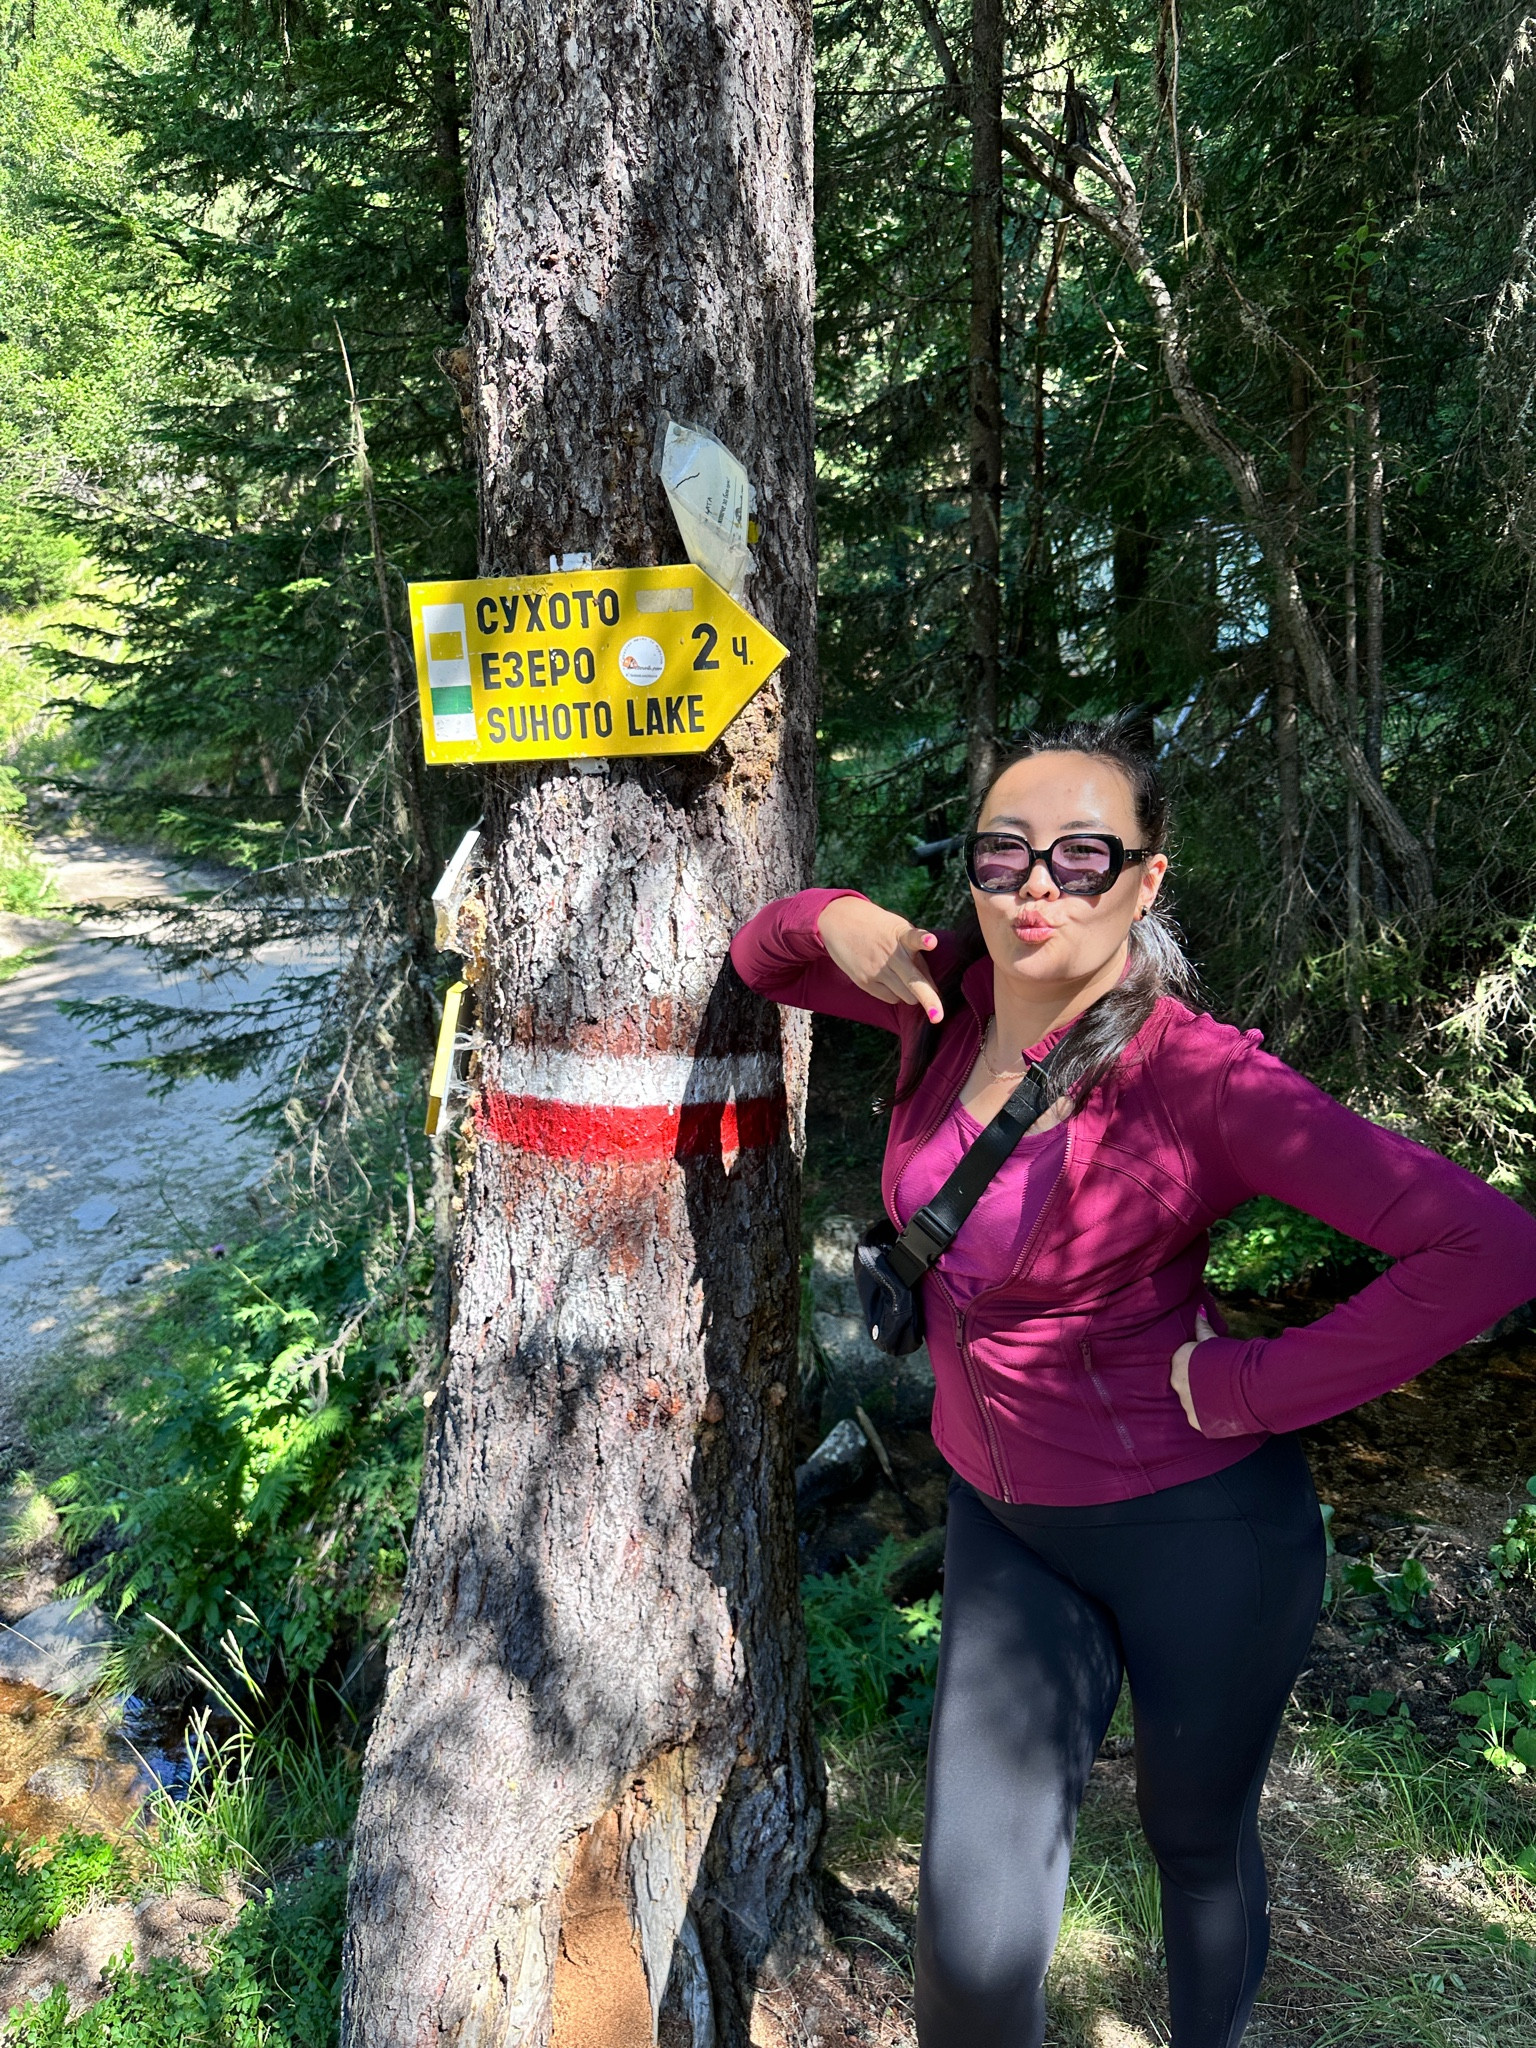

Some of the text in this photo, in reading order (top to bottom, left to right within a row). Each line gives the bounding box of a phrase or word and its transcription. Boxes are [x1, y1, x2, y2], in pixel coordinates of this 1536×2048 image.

[476, 589, 620, 635] СУХОТО
[481, 647, 595, 690] ЕЗЕРО
[691, 623, 719, 670] 2
[487, 695, 705, 743] SUHOTO LAKE
